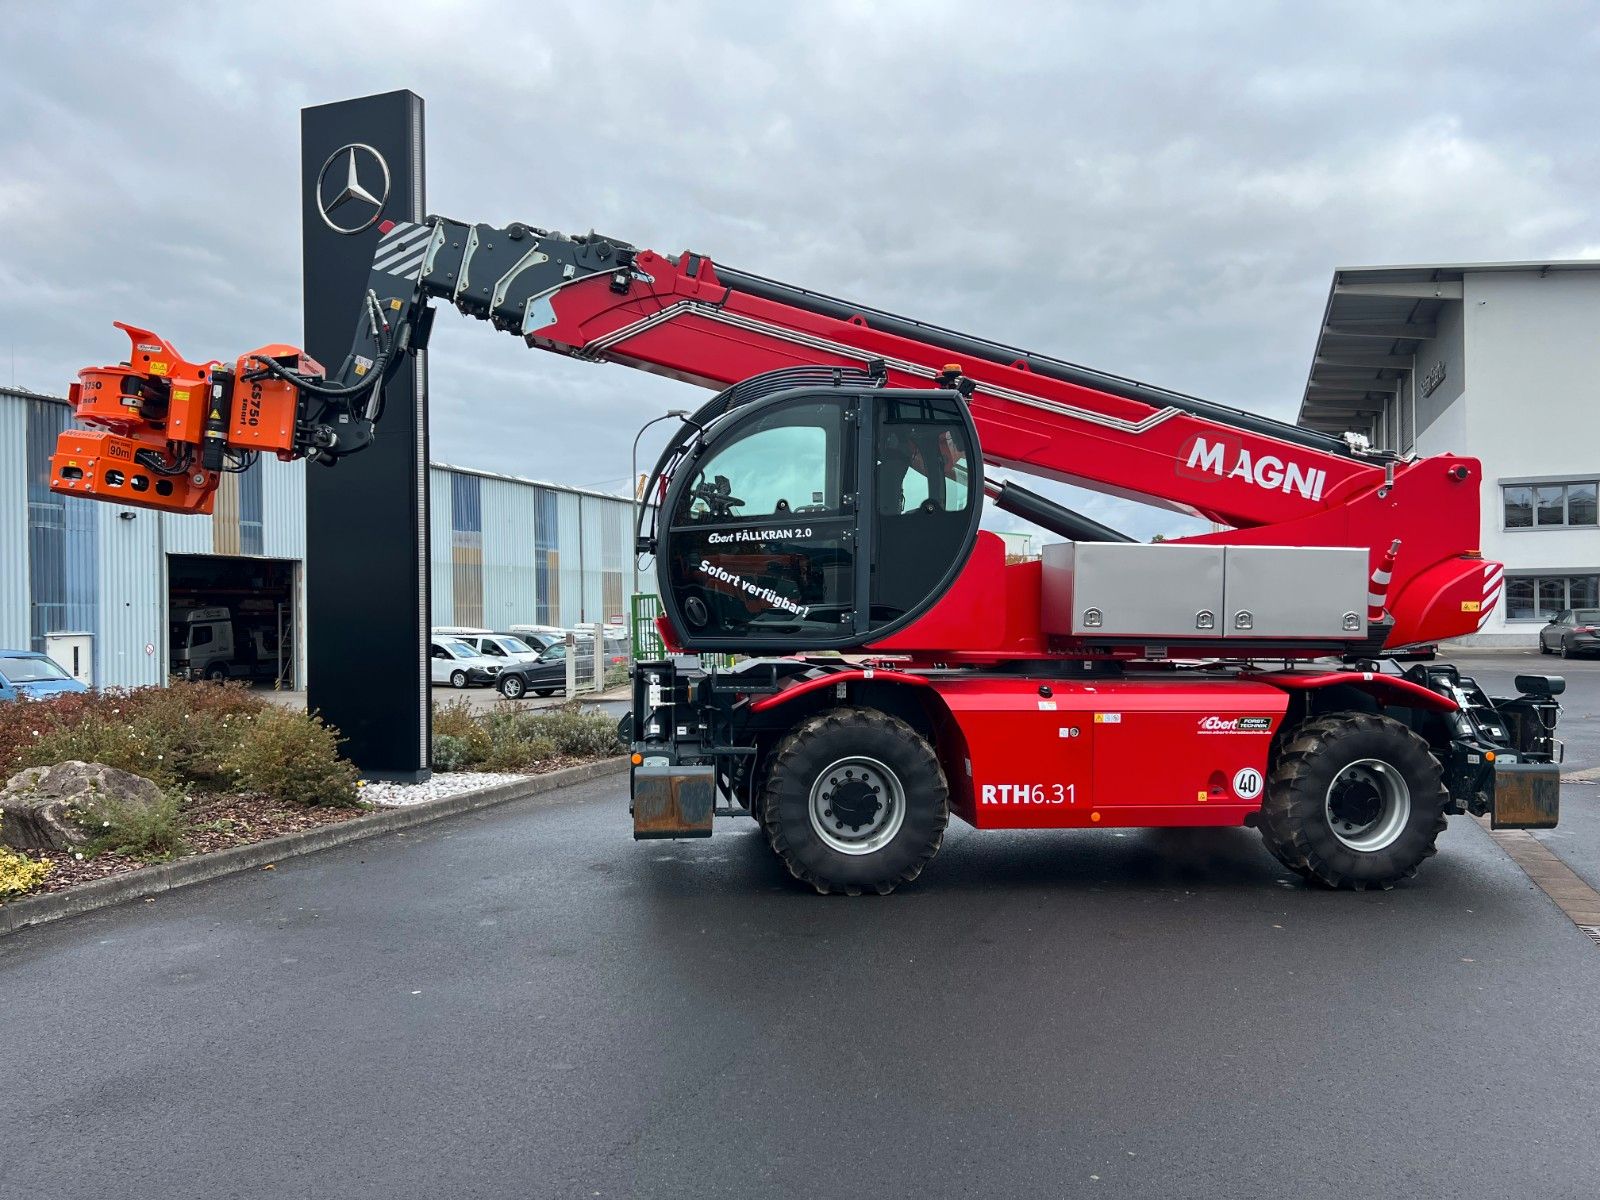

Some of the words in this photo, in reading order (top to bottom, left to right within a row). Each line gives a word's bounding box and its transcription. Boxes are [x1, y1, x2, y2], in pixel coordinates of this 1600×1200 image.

[240, 398, 248, 425] smart
[248, 383, 262, 426] CS750
[110, 445, 129, 458] 90m
[1186, 437, 1326, 501] MAGNI
[708, 532, 734, 543] Ebert
[735, 529, 793, 541] FÄLLKRAN
[794, 528, 812, 538] 2.0
[699, 560, 740, 587] Sofort
[741, 580, 810, 618] verfügbar!
[1204, 716, 1238, 730] Ebert
[1239, 774, 1256, 793] 40
